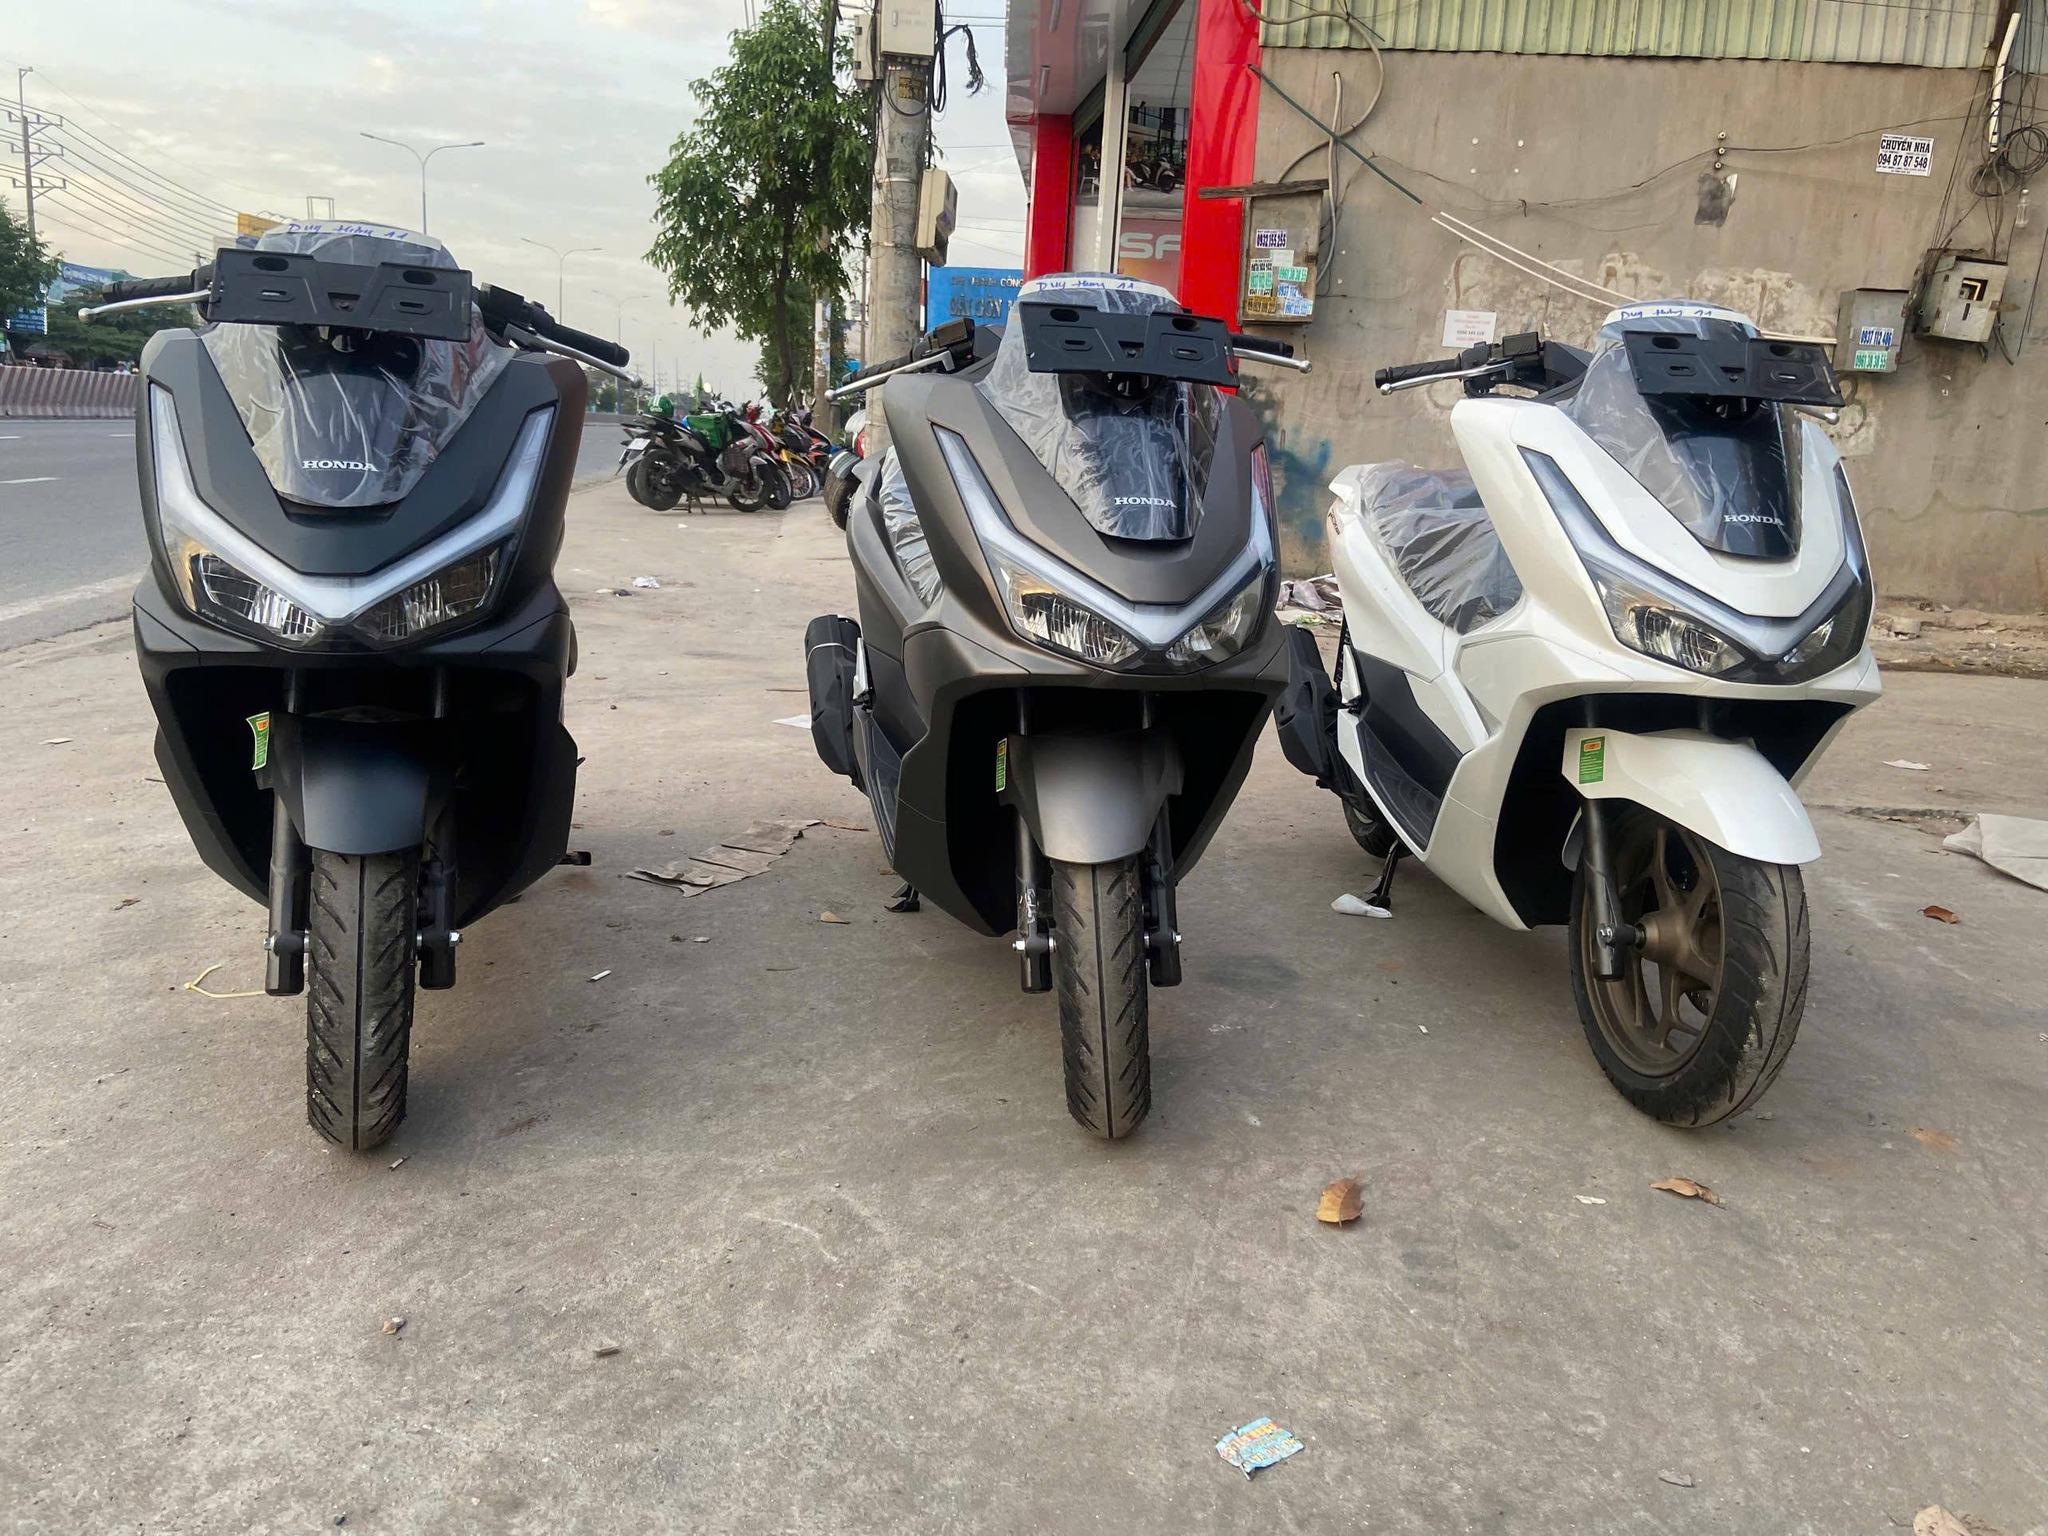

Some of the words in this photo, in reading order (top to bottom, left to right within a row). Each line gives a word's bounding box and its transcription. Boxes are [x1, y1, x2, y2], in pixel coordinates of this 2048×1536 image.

[1877, 153, 1891, 165] 094
[1892, 154, 1903, 166] 87
[1903, 155, 1914, 167] 87
[1914, 156, 1928, 168] 548
[302, 460, 379, 472] HONDA
[1114, 496, 1177, 508] HONDA
[1723, 514, 1785, 526] HONDA
